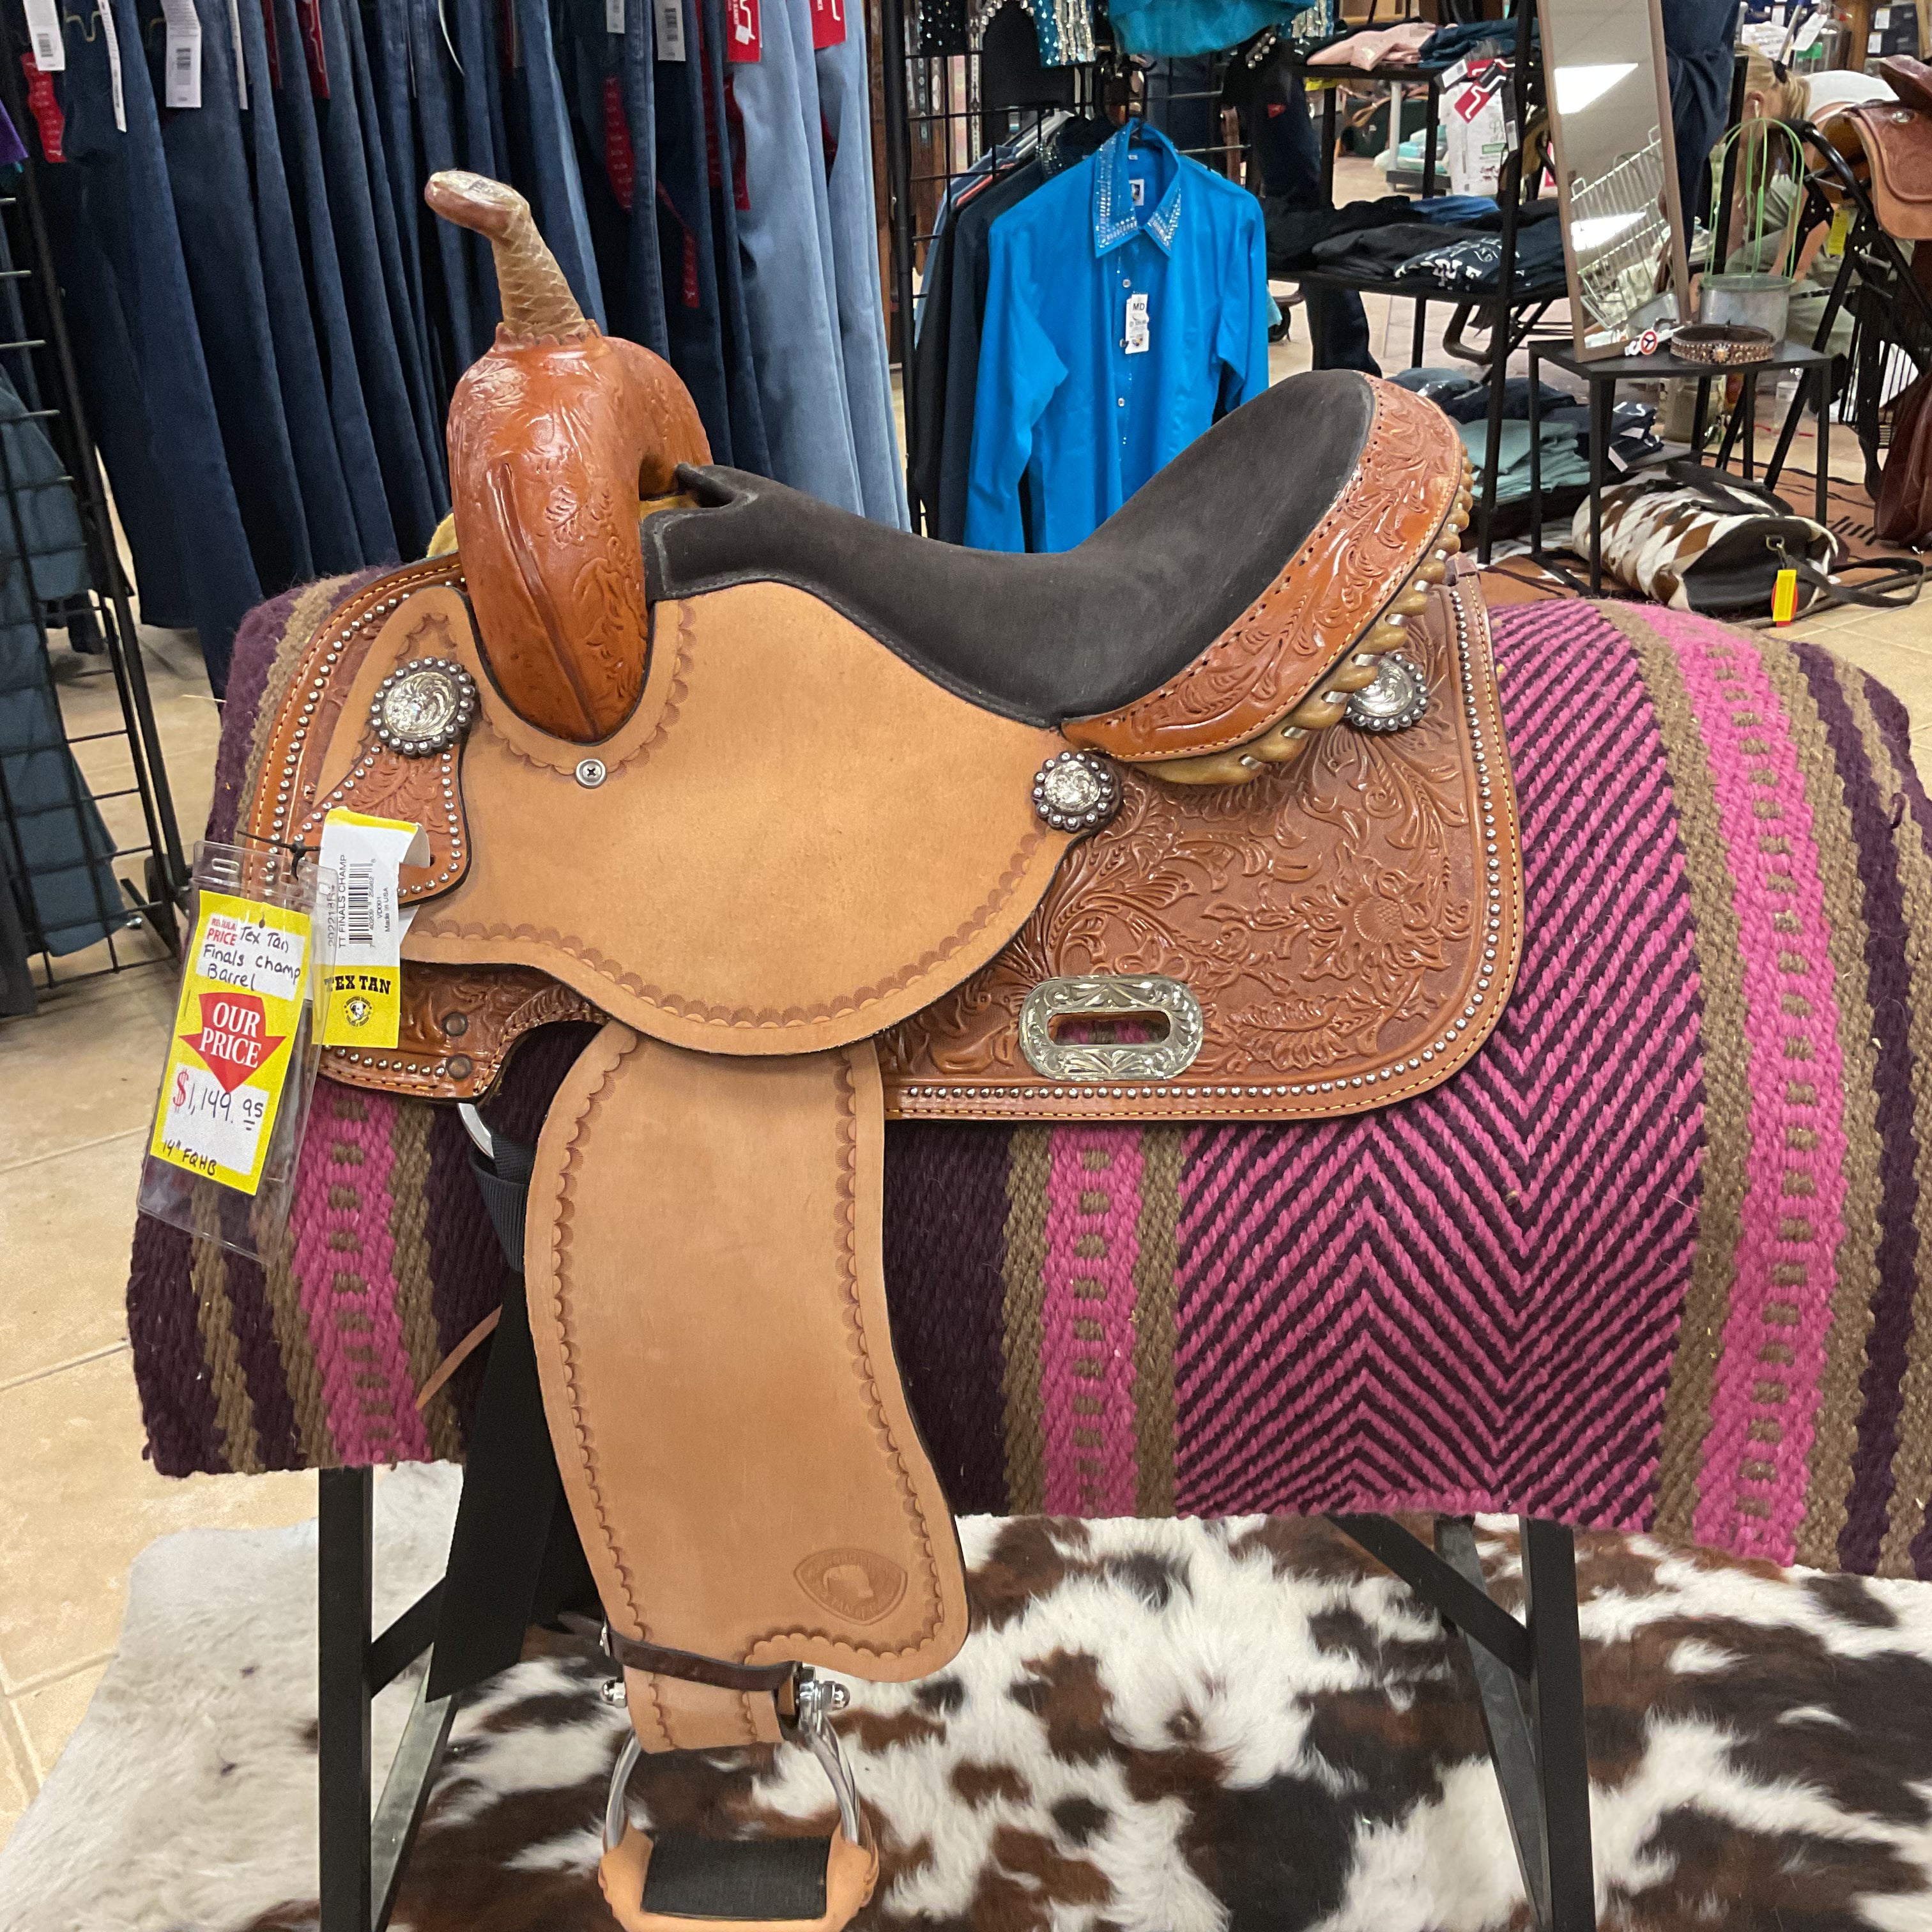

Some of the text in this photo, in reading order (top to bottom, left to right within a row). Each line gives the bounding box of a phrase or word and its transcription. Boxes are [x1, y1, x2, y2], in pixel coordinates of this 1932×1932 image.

[206, 928, 238, 946] PRICE
[240, 926, 289, 953] Tex Tan
[339, 937, 346, 949] TT
[203, 944, 244, 967] Finals
[208, 963, 256, 991] Barrel
[324, 975, 391, 995] TEX TAN
[213, 1002, 261, 1038] OUR
[199, 1027, 261, 1068] PRICE
